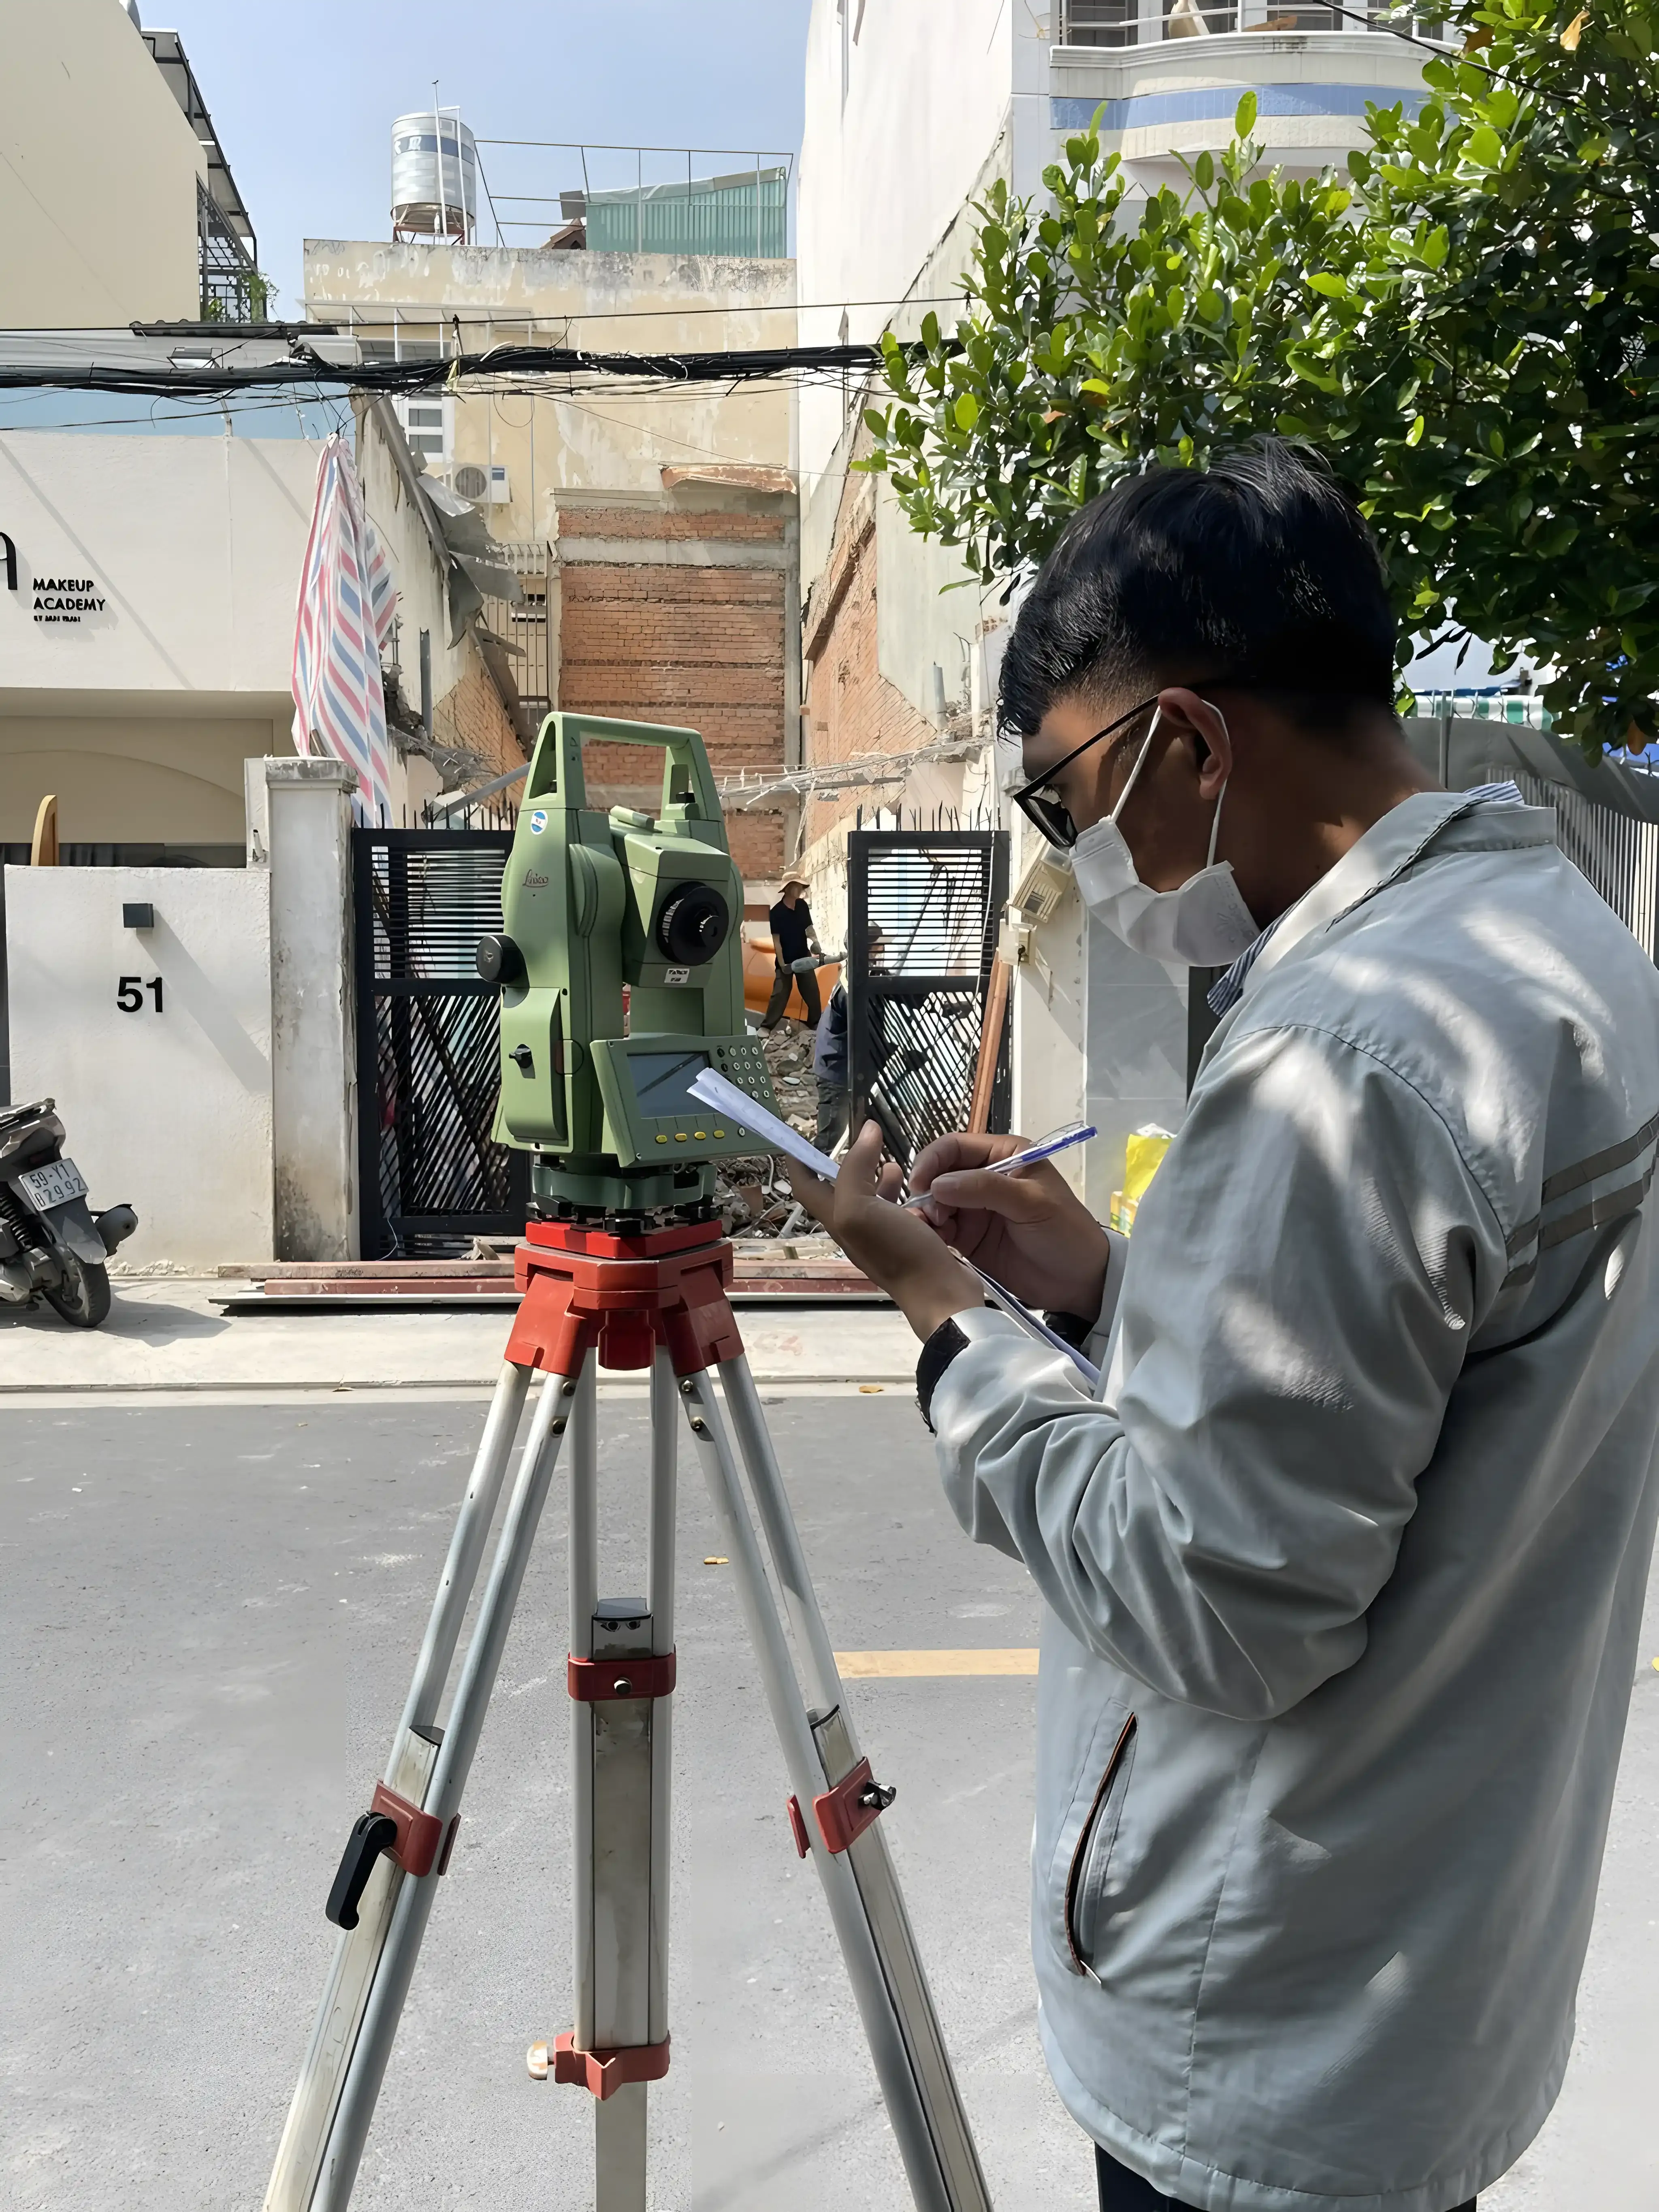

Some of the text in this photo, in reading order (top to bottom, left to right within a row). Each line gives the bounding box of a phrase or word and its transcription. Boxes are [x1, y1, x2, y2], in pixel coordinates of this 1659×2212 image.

[33, 578, 94, 592] MAKEUP
[33, 597, 106, 611] ACADEMY
[117, 976, 163, 1013] 51
